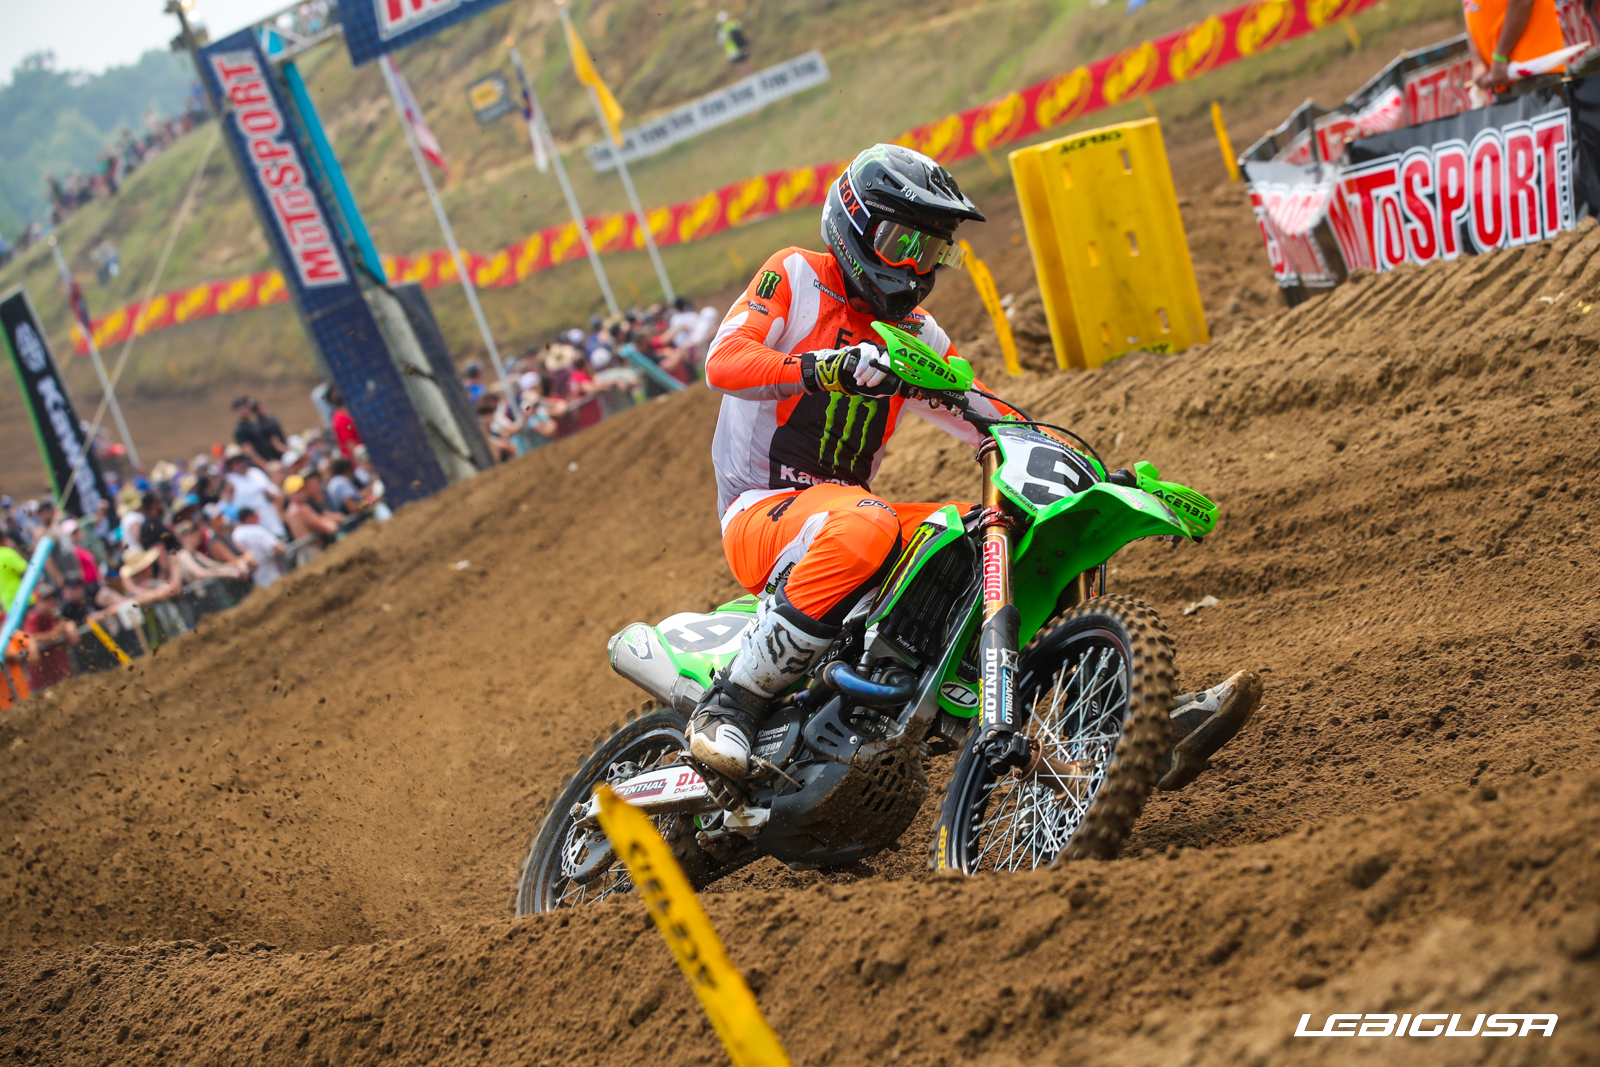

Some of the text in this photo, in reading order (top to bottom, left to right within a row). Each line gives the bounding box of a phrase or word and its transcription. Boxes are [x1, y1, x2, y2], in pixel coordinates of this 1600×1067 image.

[212, 55, 345, 285] MOTOSPORT
[839, 179, 860, 217] FOX
[900, 185, 918, 202] FOX
[1327, 116, 1568, 272] MTOSPORT
[814, 280, 847, 305] Kawasak
[895, 347, 958, 384] ACERBIS
[1152, 489, 1211, 525] ACERBIS
[983, 540, 1003, 605] SHOWA
[896, 635, 910, 650] Twin
[985, 647, 998, 725] DUNLOP
[937, 825, 948, 874] NLOP
